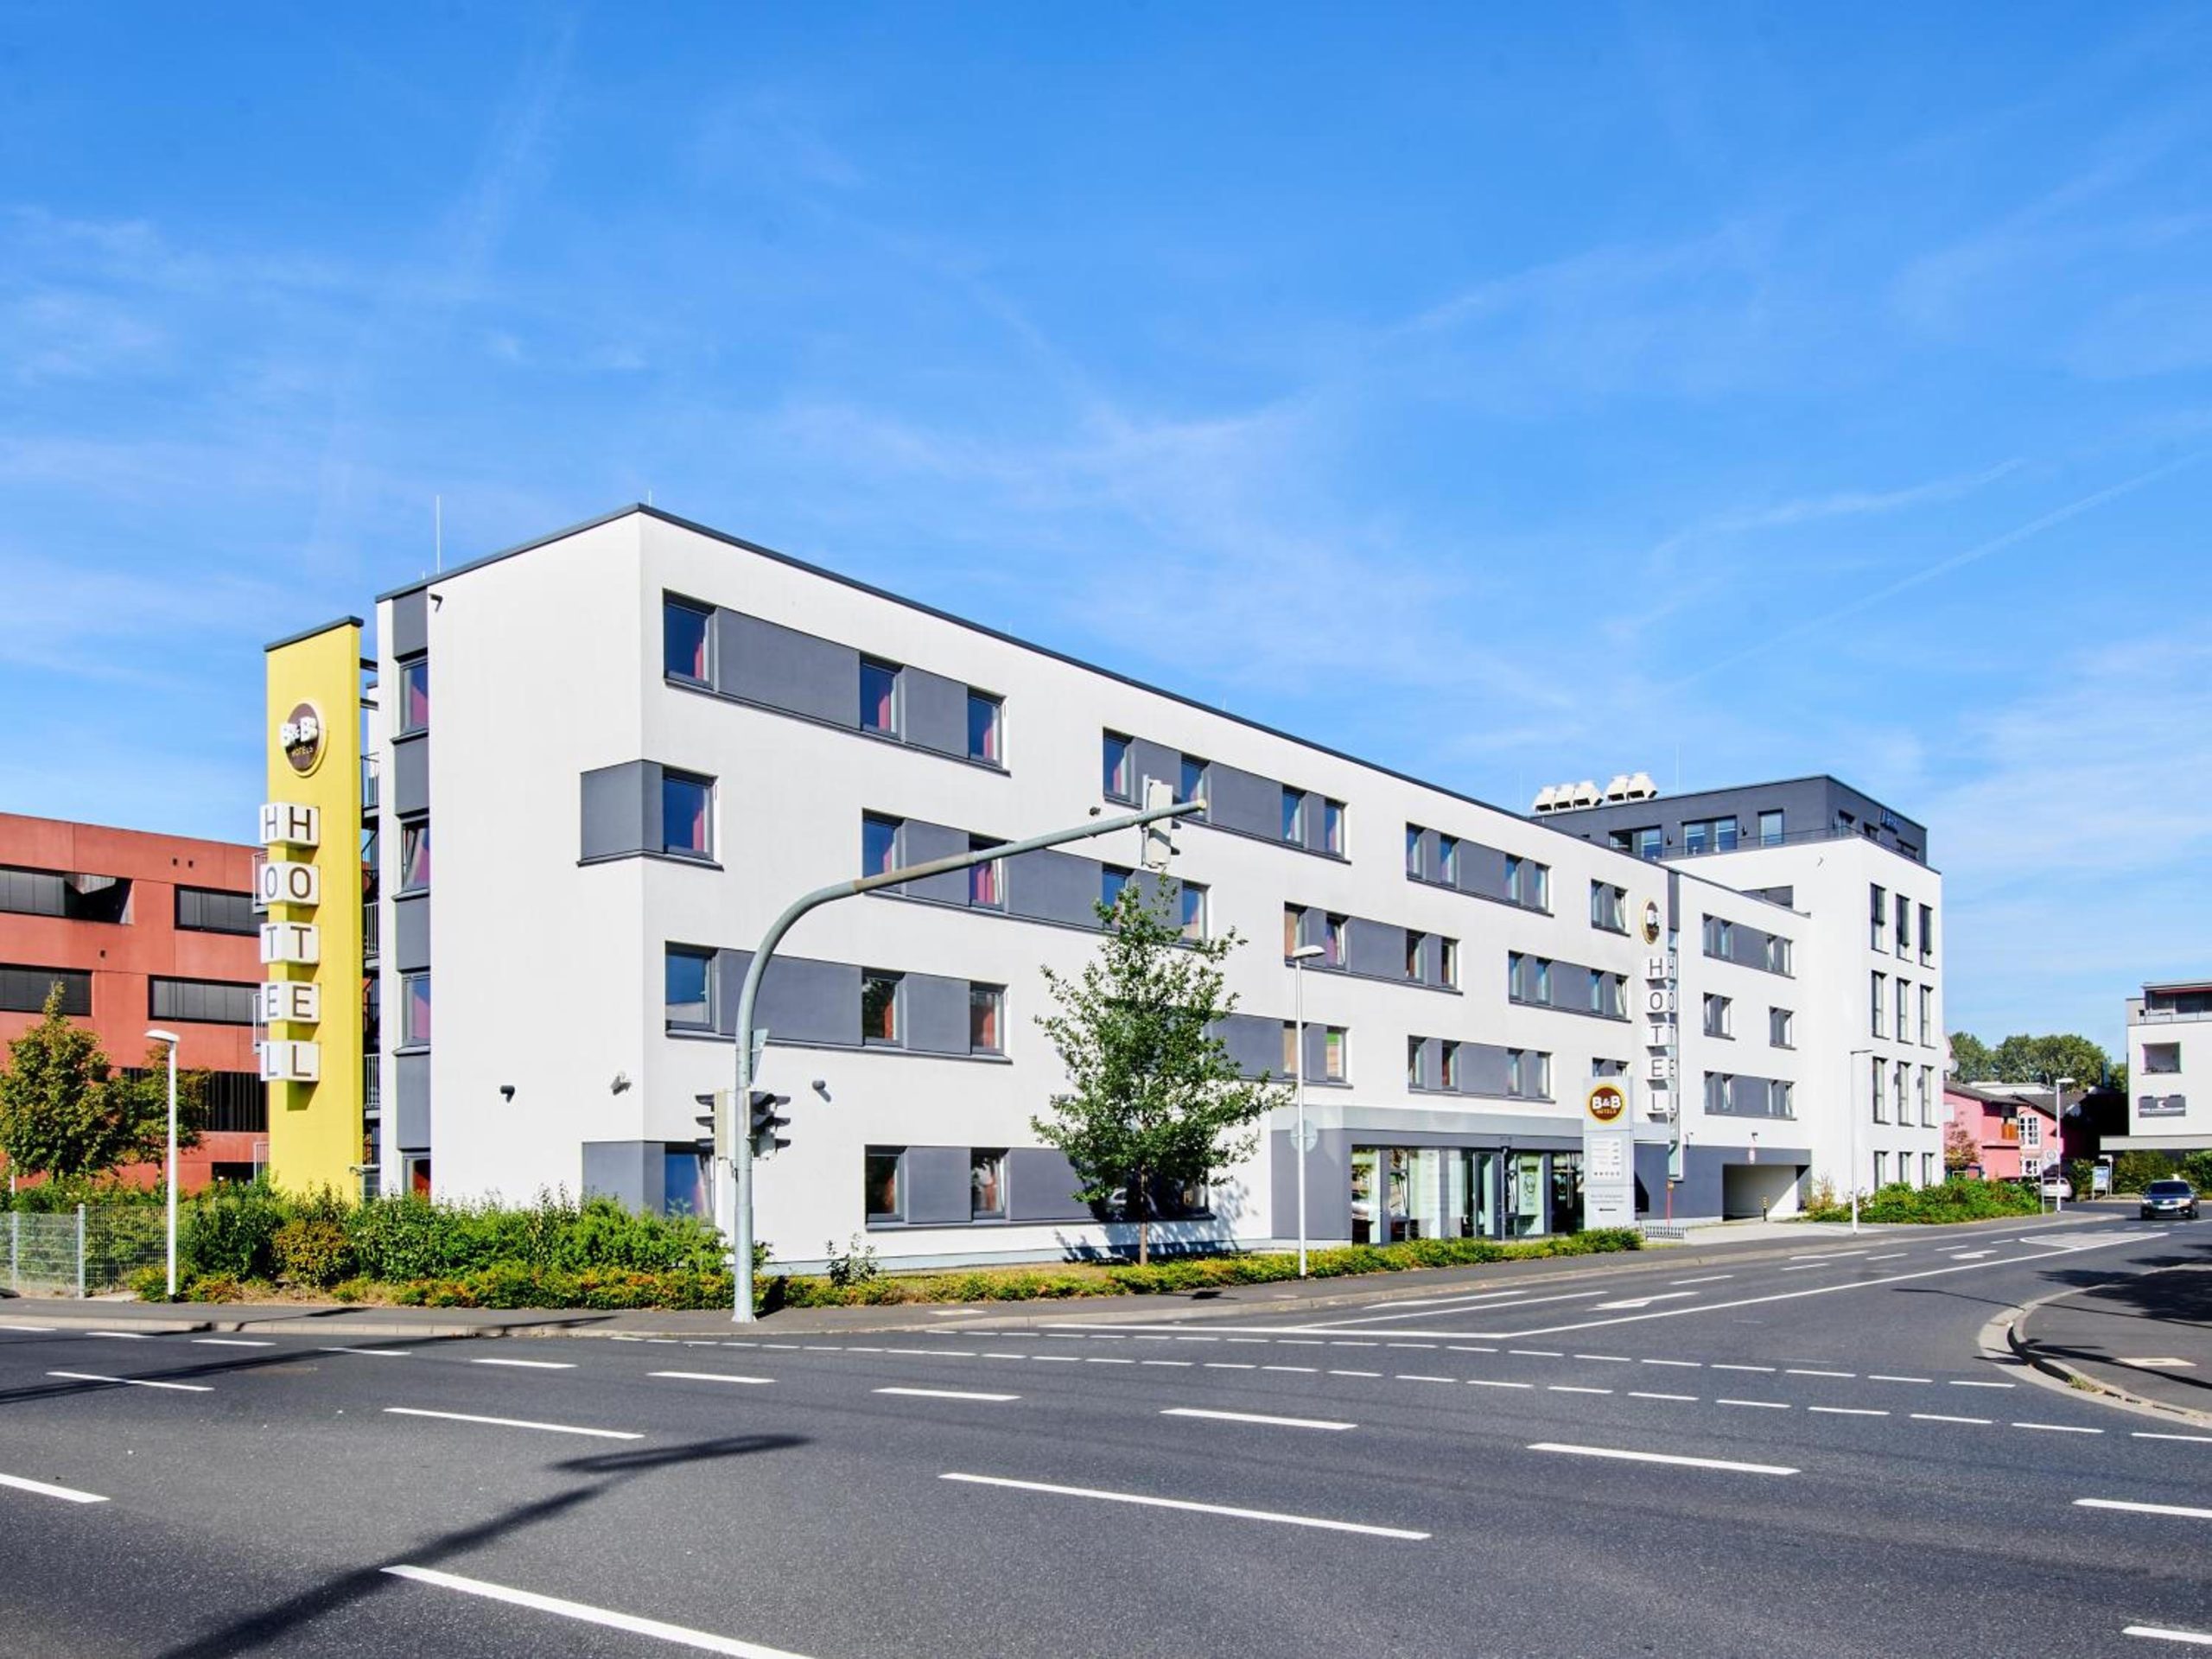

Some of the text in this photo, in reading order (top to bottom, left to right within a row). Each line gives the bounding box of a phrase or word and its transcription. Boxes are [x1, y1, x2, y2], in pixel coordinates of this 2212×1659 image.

[264, 804, 278, 1077] HOTEL
[289, 805, 312, 1077] HOTEL
[1649, 957, 1664, 1111] HOTEL
[1592, 1095, 1621, 1109] B&B
